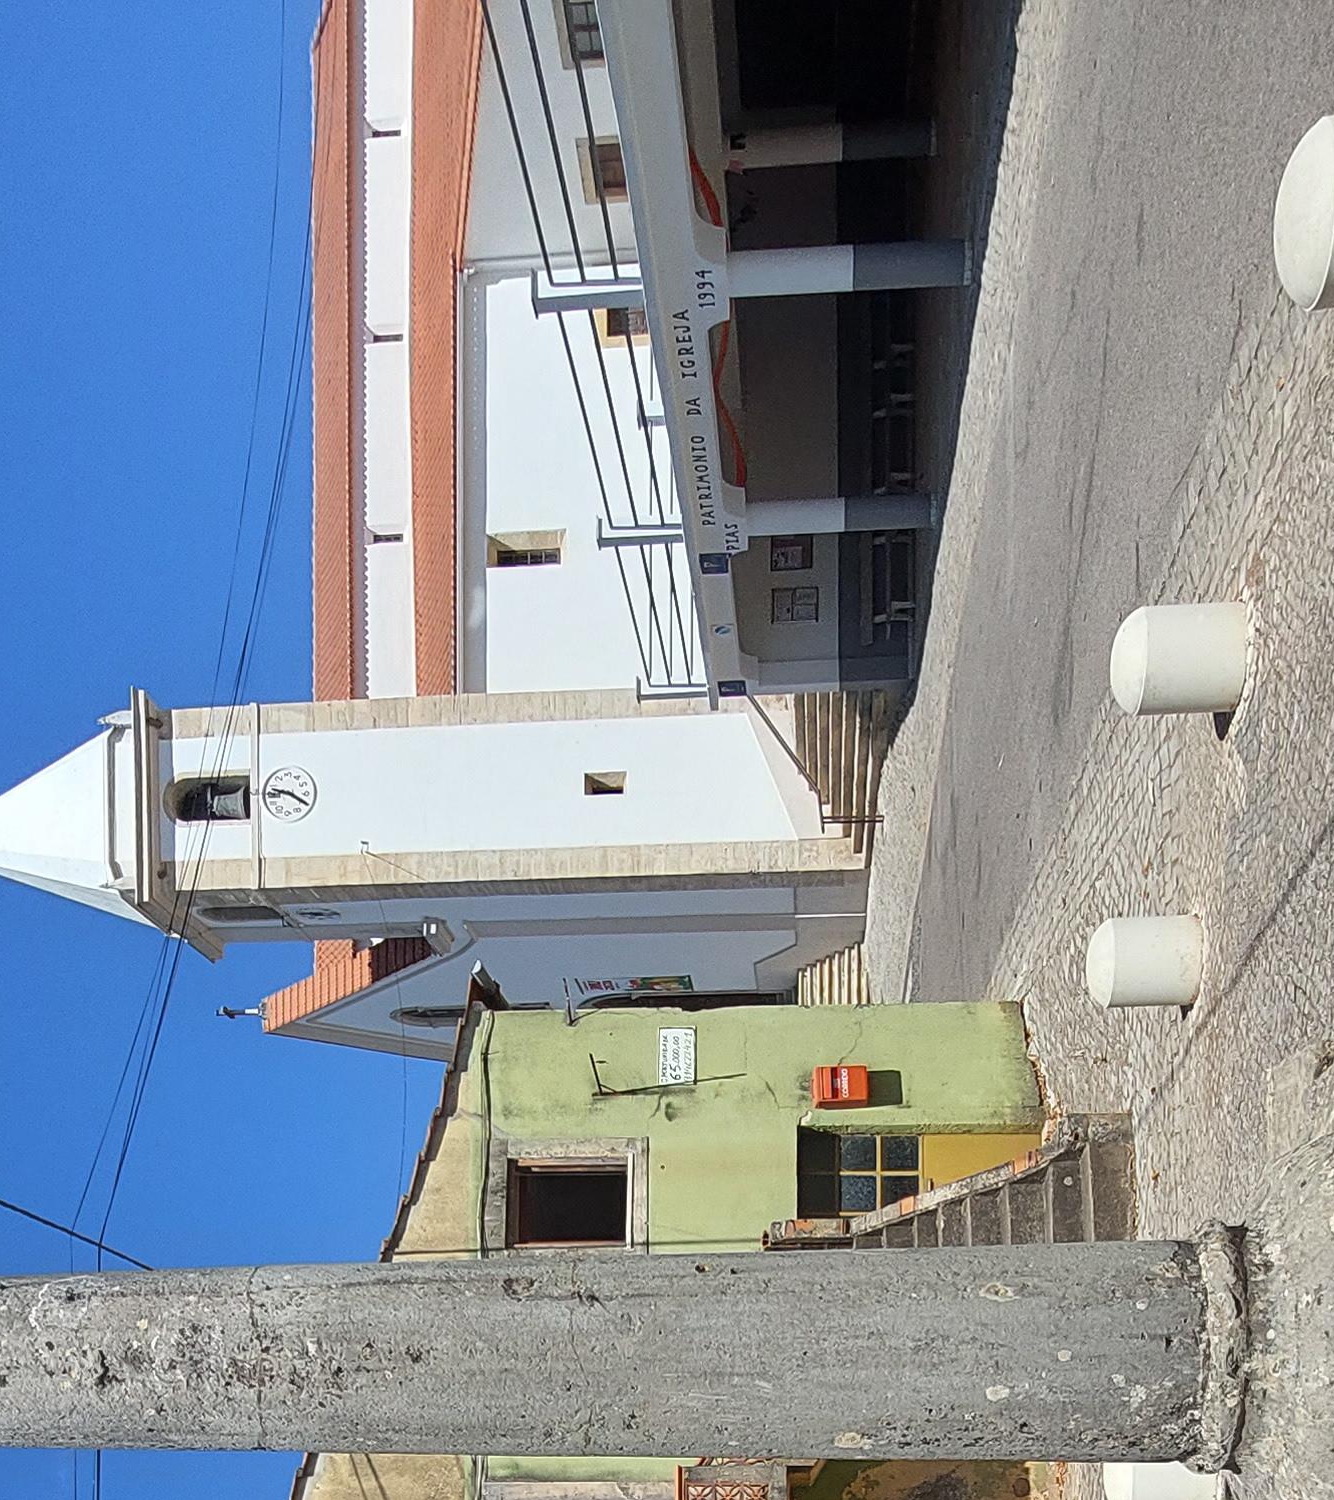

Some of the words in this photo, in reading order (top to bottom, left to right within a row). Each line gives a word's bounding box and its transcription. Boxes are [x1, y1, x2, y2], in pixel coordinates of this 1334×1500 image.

[694, 269, 716, 309] 1994
[672, 309, 697, 379] IGREJA
[686, 397, 702, 416] DA
[690, 435, 715, 526] PATRIMONIO
[724, 524, 740, 551] PIAS
[275, 806, 283, 814] 10
[669, 1036, 681, 1080] 65.000,00
